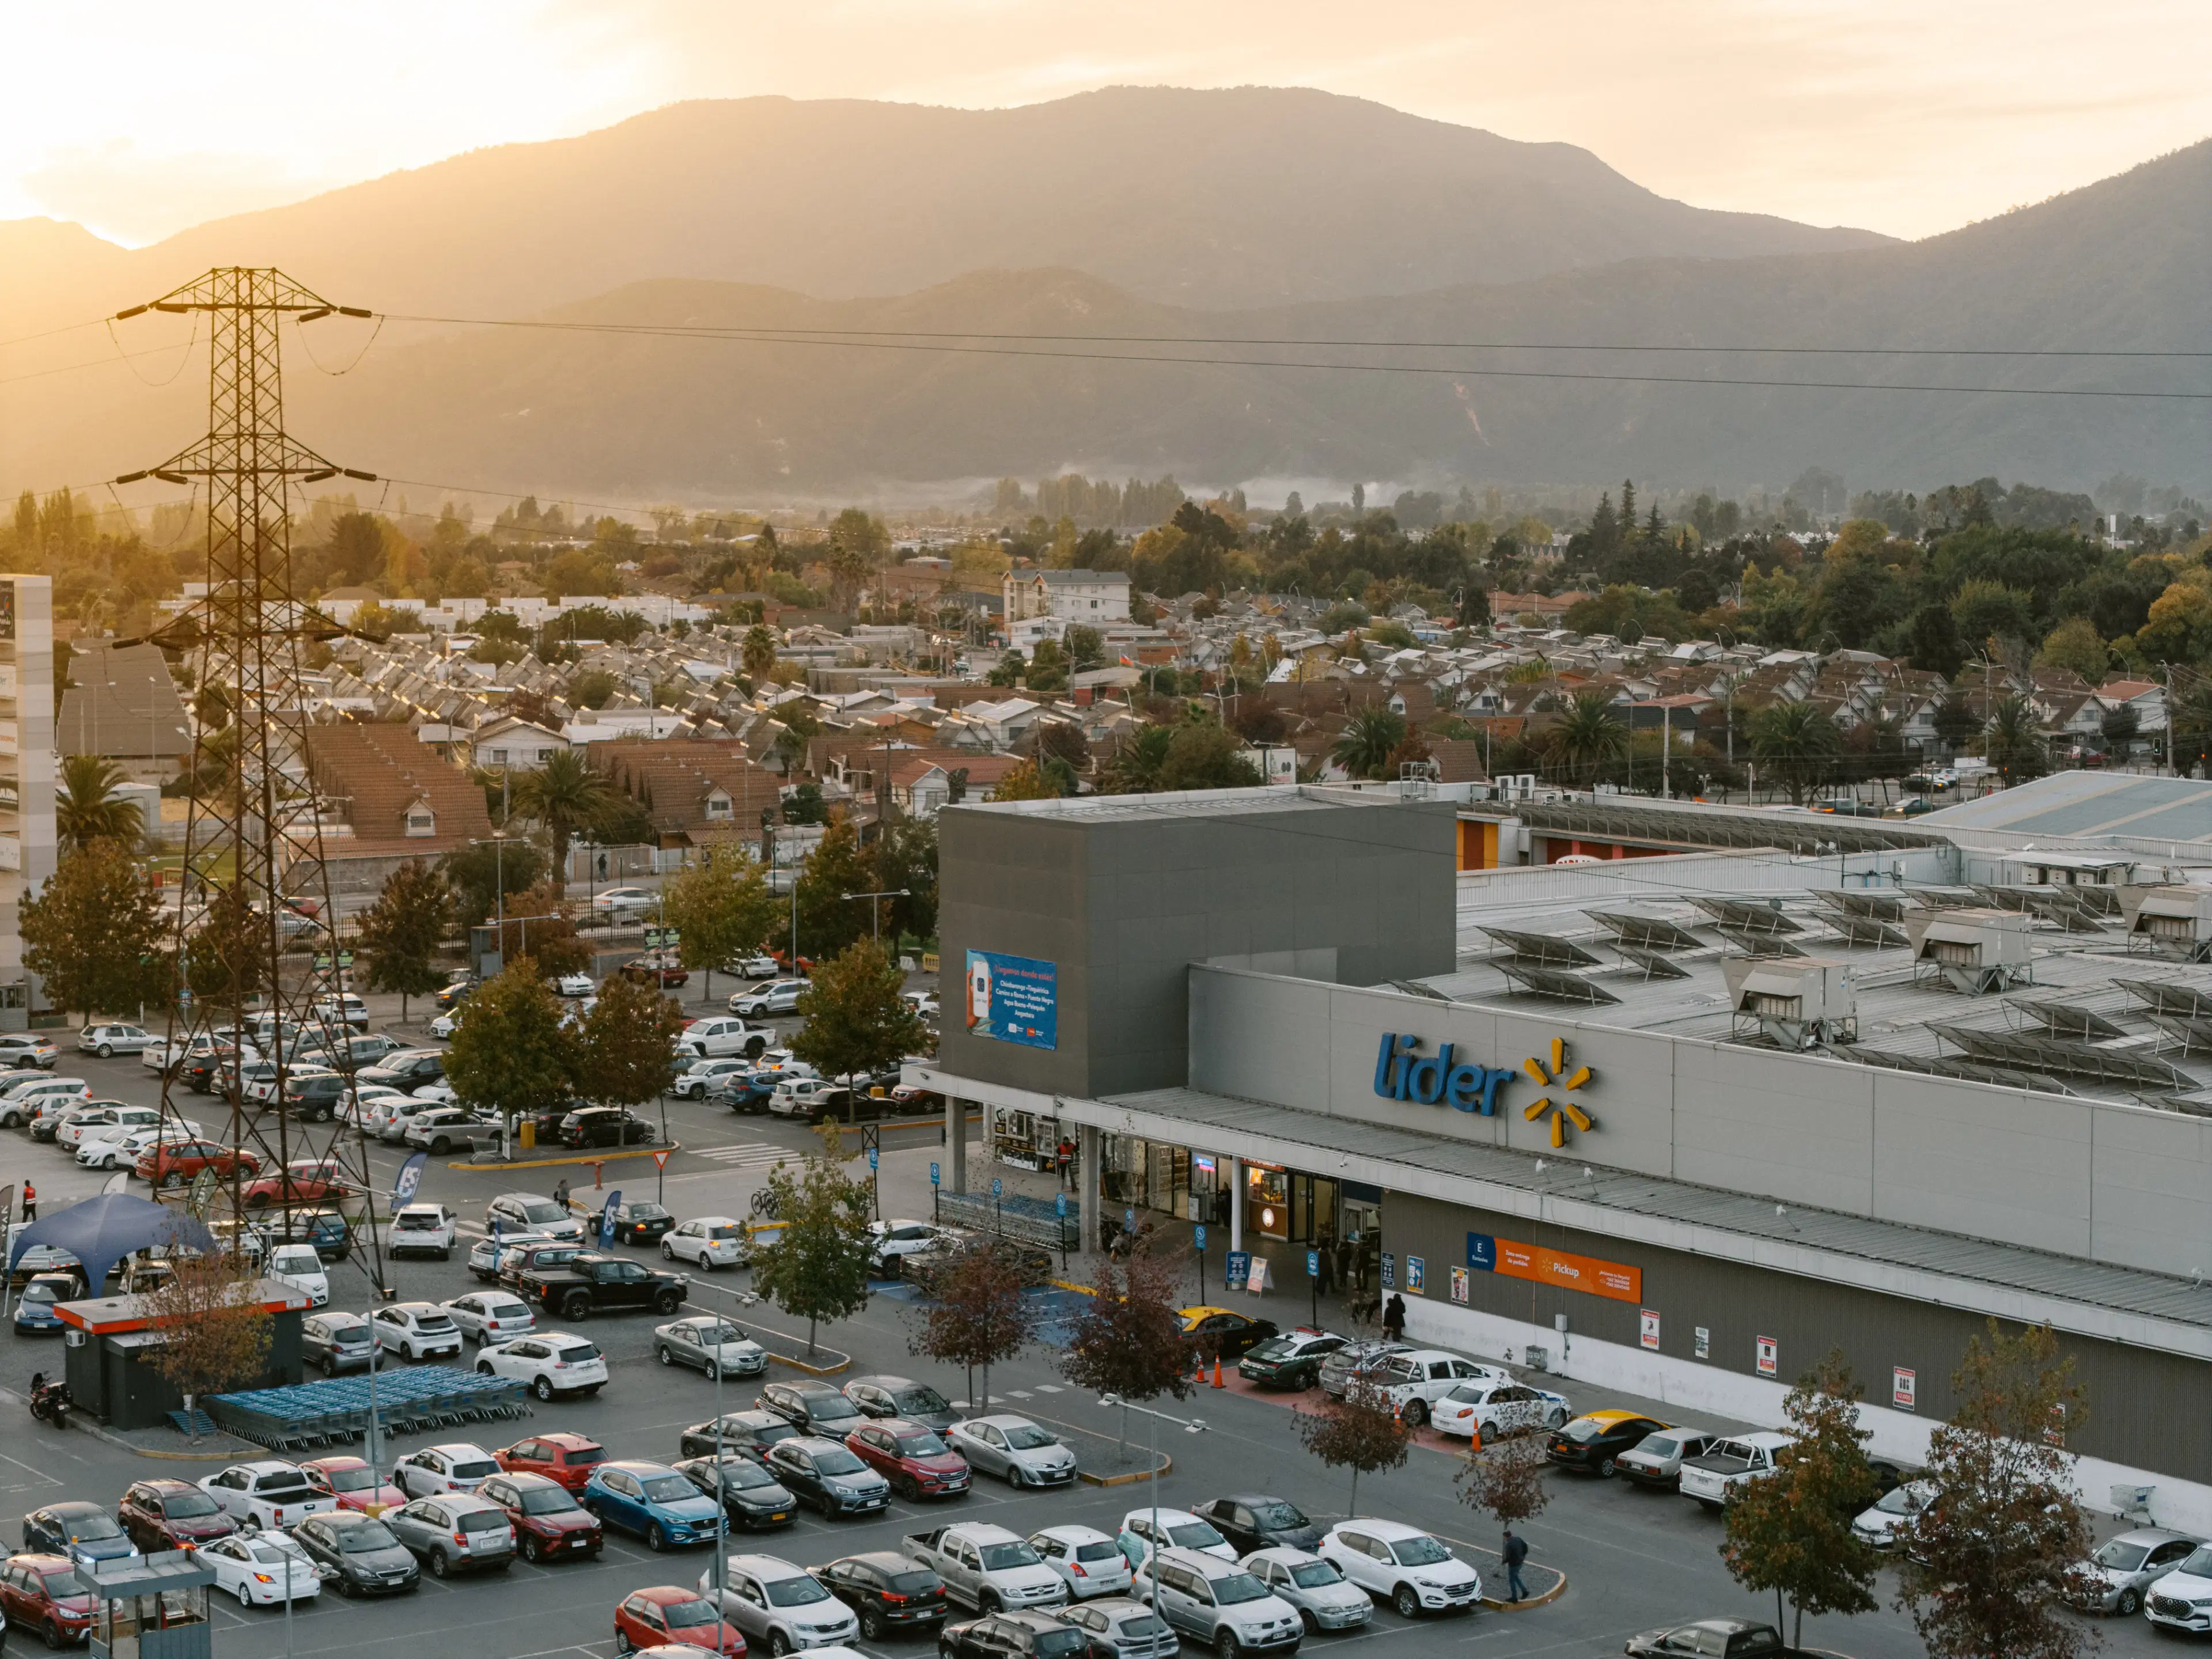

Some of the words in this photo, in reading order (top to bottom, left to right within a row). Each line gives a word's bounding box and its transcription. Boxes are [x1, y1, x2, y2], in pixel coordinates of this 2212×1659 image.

[1477, 1243, 1482, 1253] E
[1505, 1249, 1515, 1257] Zona
[1553, 1262, 1579, 1279] Pickup
